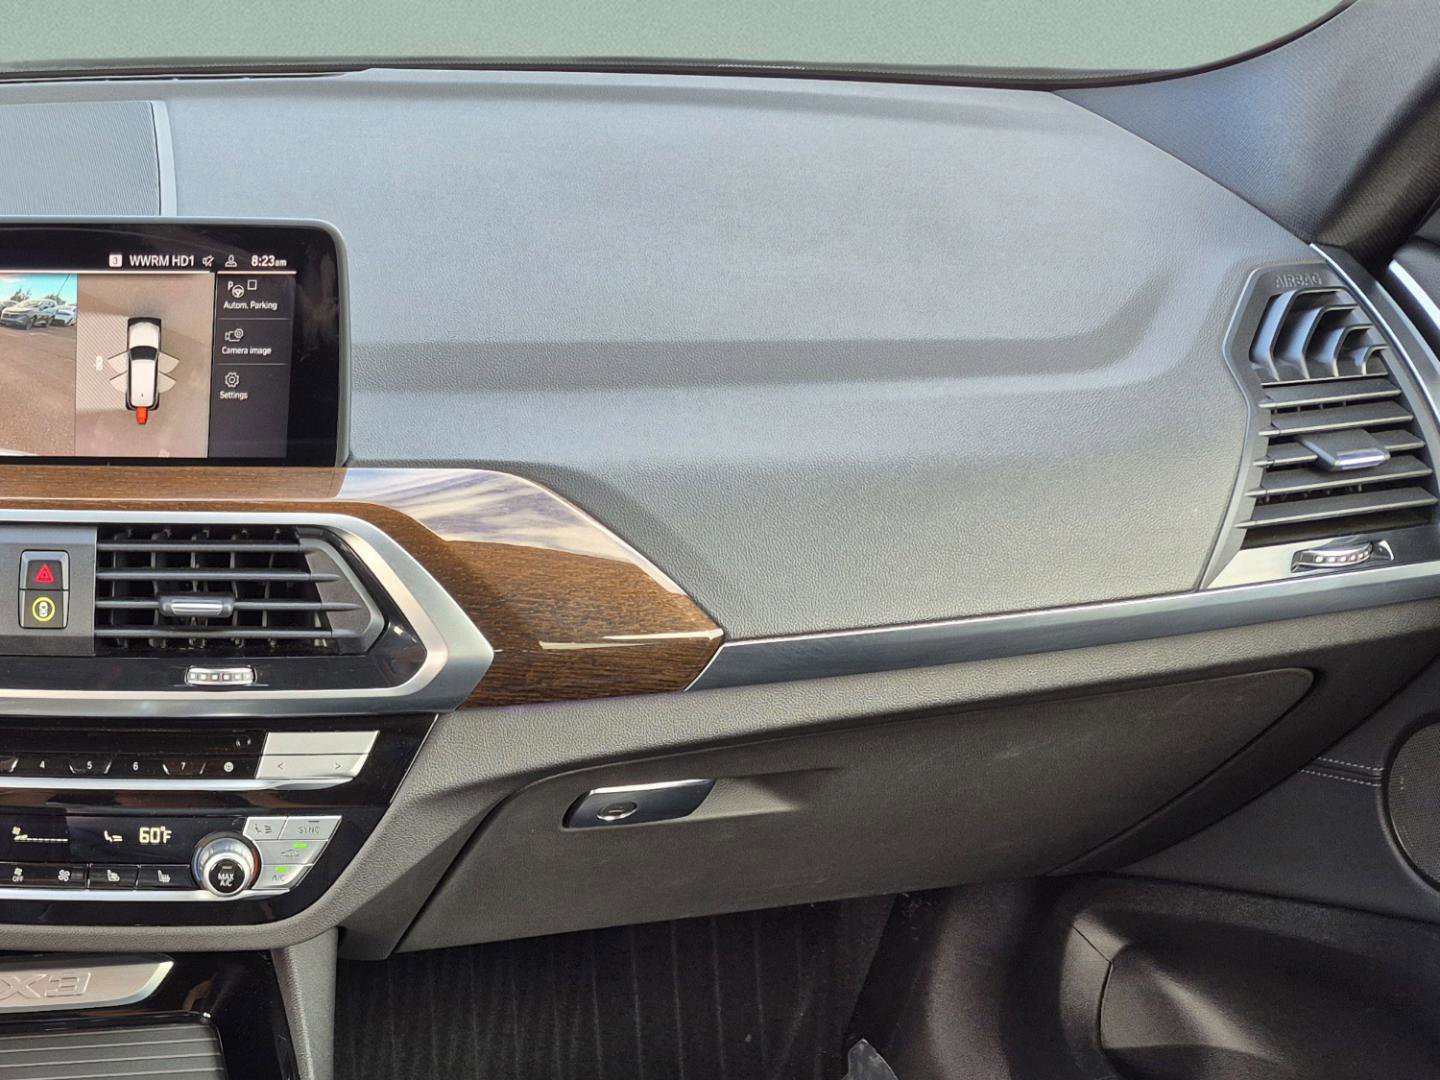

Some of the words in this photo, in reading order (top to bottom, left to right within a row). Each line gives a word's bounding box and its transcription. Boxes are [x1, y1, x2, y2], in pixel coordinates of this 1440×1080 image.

[129, 254, 168, 266] WWRM
[172, 254, 195, 266] HD1
[1275, 273, 1323, 288] AIRBAG
[223, 301, 249, 309] Autom.
[250, 301, 278, 311] Parking
[221, 346, 248, 355] Camera
[249, 346, 272, 356] image
[219, 390, 248, 401] Settings
[39, 760, 46, 769] 4
[86, 760, 93, 770] 5
[132, 761, 139, 771] 6
[180, 762, 186, 770] 7
[217, 872, 235, 881] MAX
